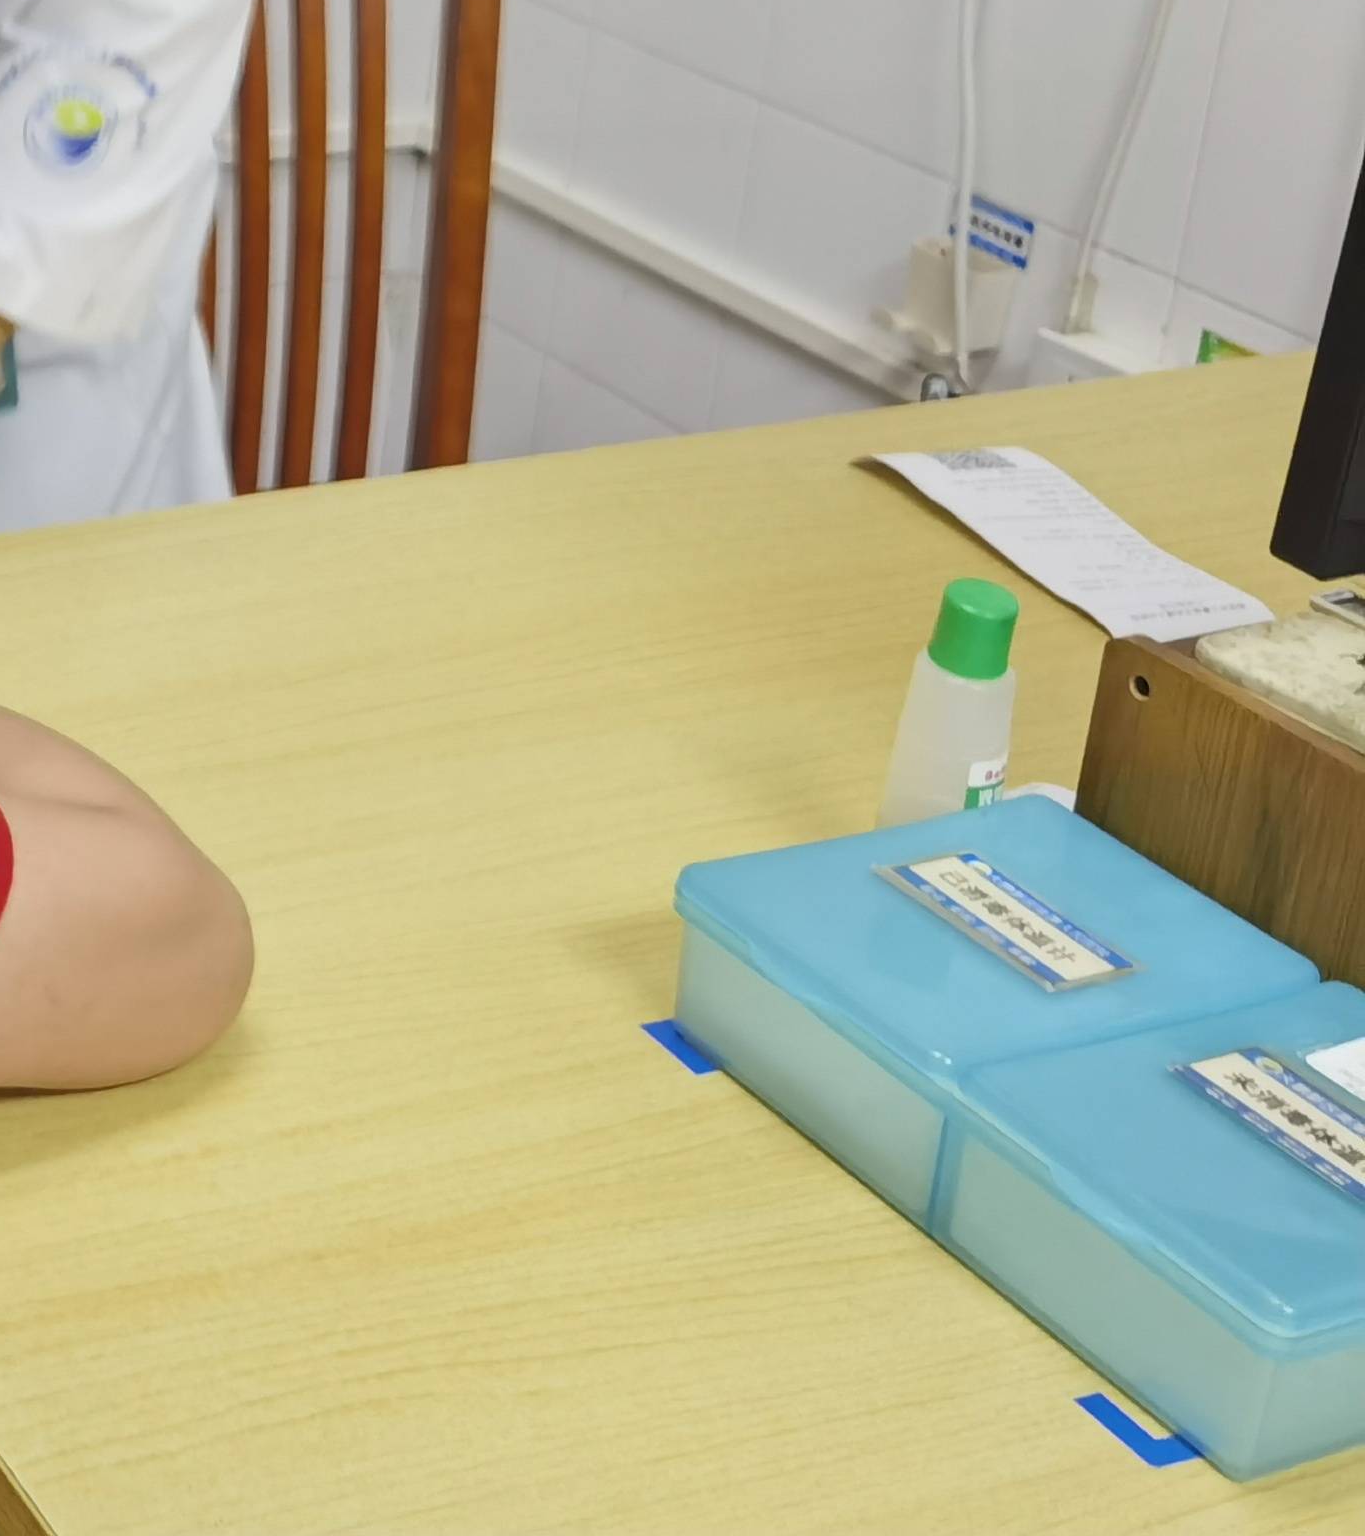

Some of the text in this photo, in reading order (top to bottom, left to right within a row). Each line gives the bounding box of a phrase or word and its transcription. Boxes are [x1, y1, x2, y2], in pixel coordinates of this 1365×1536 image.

[1222, 1071, 1365, 1174] 未消毒体温
